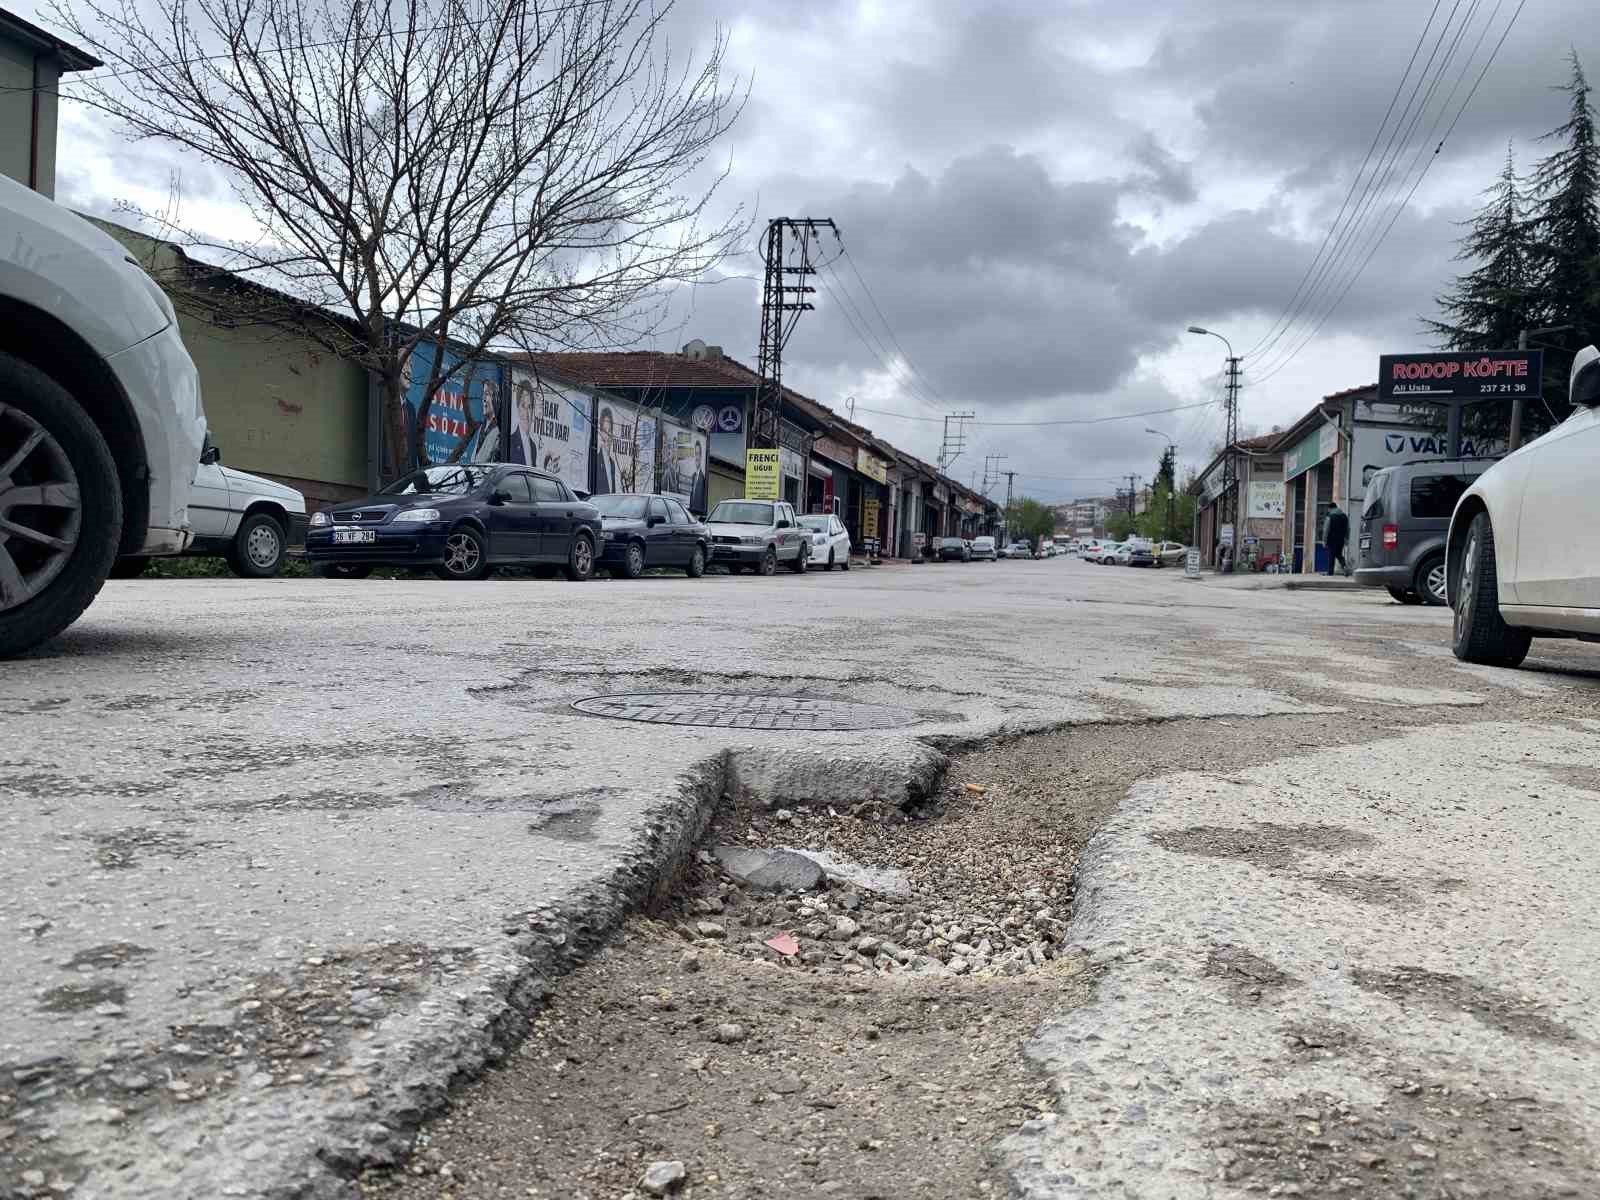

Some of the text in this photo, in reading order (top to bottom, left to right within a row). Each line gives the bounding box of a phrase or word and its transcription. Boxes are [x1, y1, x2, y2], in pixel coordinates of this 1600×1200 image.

[1393, 358, 1528, 379] RODOP KÖFTE
[1480, 384, 1497, 393] 237
[1500, 384, 1511, 392] 21
